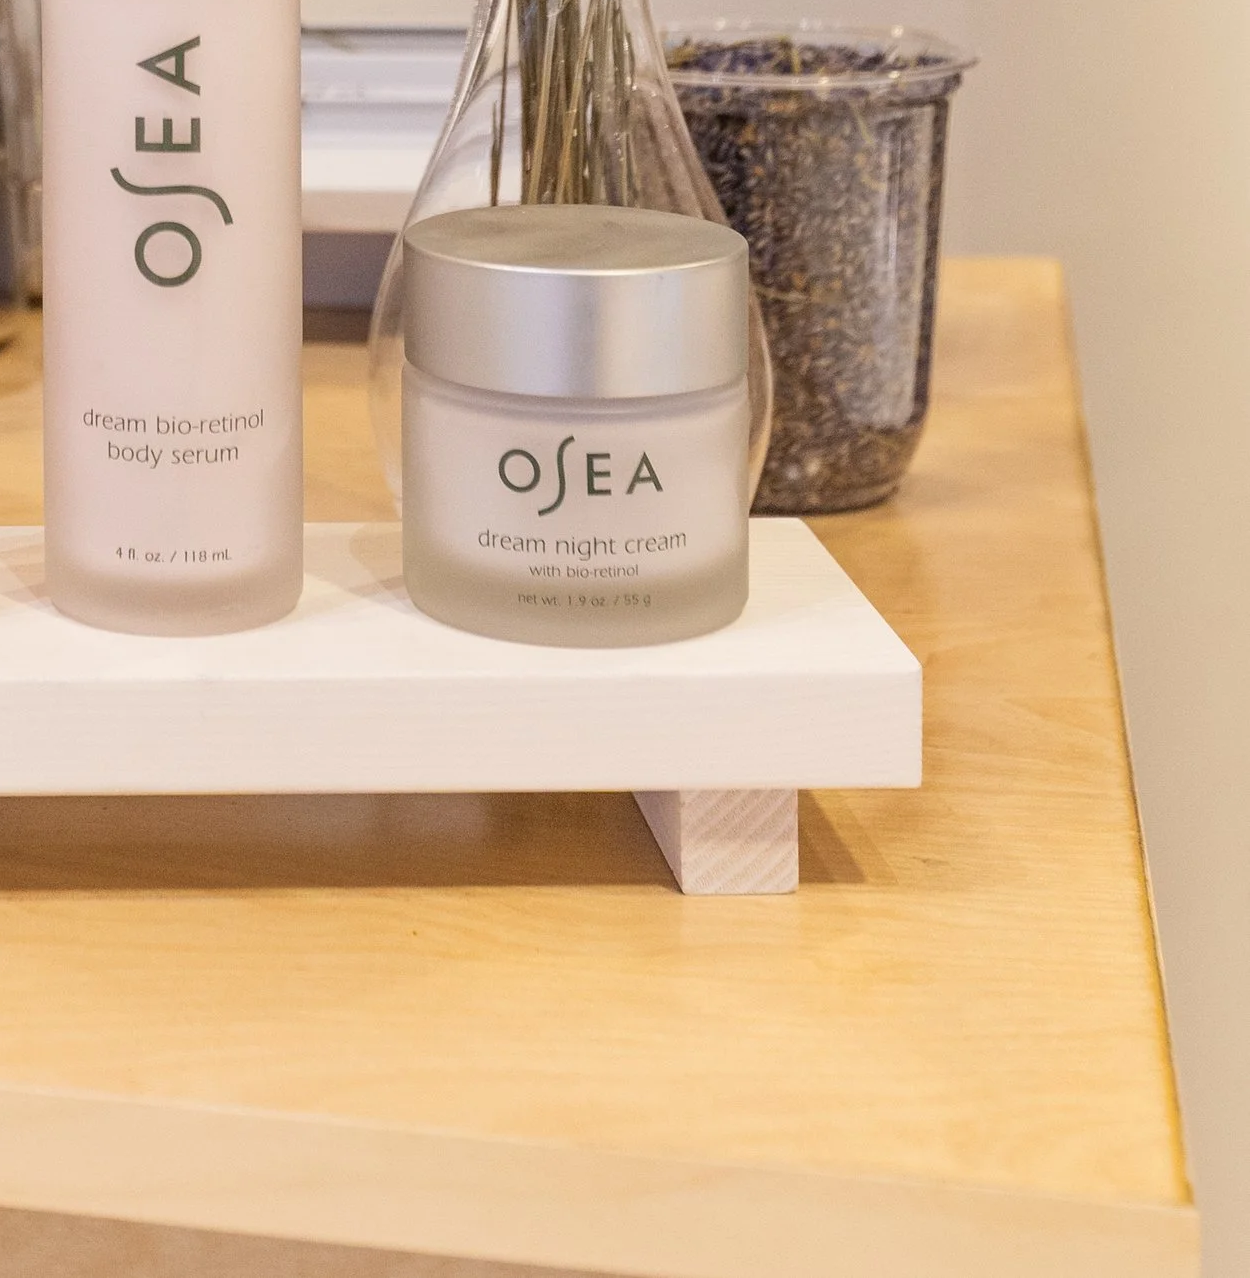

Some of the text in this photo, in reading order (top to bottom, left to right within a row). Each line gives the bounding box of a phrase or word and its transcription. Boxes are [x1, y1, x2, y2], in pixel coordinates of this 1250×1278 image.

[109, 35, 234, 288] OSEA
[82, 408, 264, 435] dream bio-retinol
[107, 440, 239, 469] body serum
[498, 435, 664, 517] OSEA
[115, 546, 123, 559] 4
[127, 547, 138, 561] fl.
[144, 551, 165, 563] oz.
[169, 550, 178, 564] /
[183, 550, 208, 563] 118
[477, 528, 687, 562] dream night cream
[528, 563, 639, 580] with bio-retinol
[517, 593, 538, 605] net
[623, 594, 640, 606] 55
[642, 594, 652, 608] g
